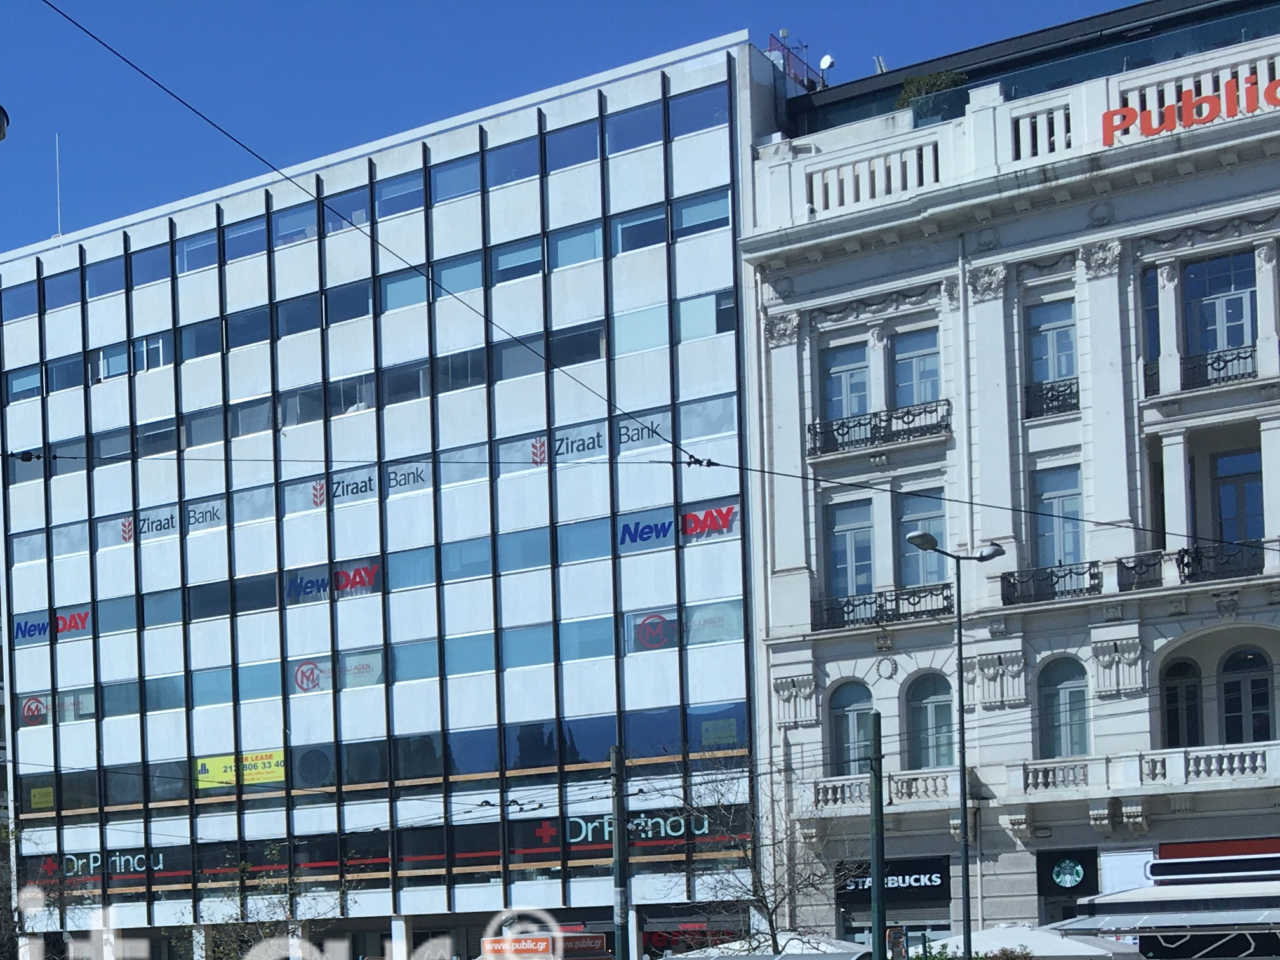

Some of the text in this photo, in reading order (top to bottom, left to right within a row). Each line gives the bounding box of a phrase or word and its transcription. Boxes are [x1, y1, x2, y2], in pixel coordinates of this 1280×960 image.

[554, 421, 661, 457] Ziraat Bank
[331, 467, 425, 498] Ziraat Bank
[139, 506, 221, 534] Ziraat Bank
[620, 505, 735, 545] New DAY
[287, 564, 379, 598] New DAY
[15, 611, 89, 640] New DAY
[846, 873, 942, 890] STABUCKS
